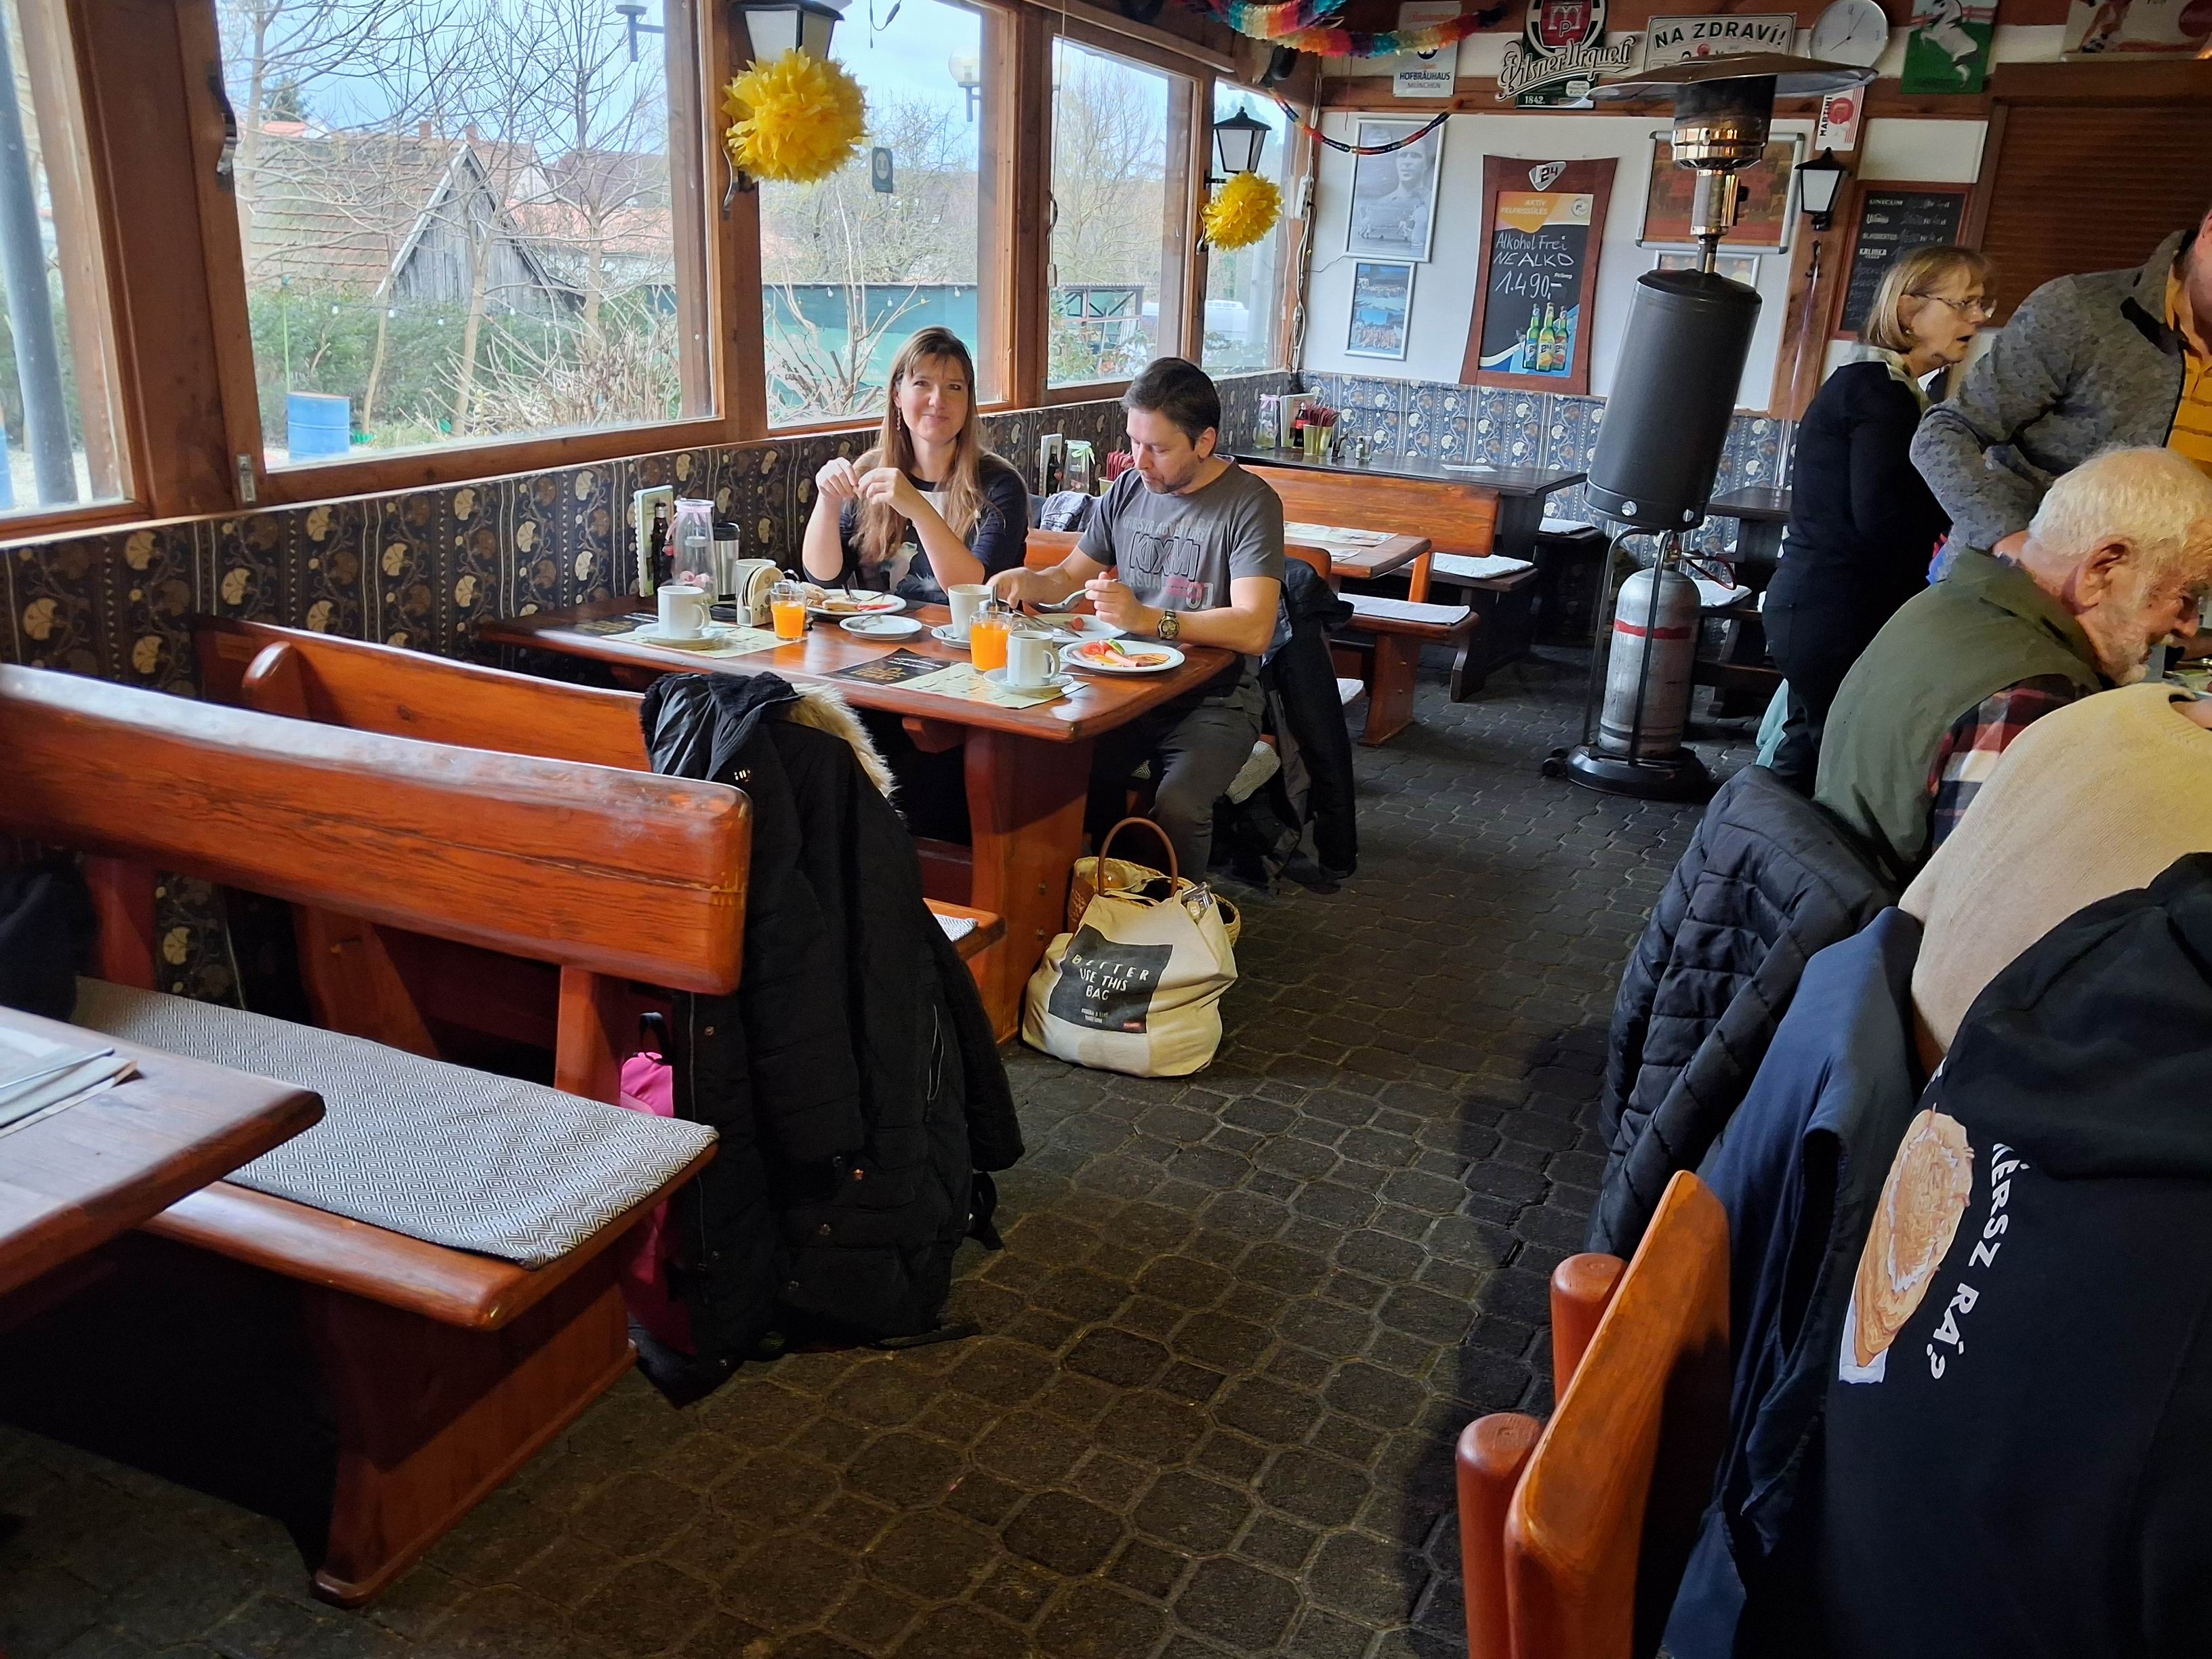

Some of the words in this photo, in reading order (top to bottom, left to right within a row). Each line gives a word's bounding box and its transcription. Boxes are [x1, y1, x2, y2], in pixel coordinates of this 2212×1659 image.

[1655, 28, 1684, 49] NA
[1693, 22, 1786, 46] ZDRAVÍ!
[1399, 71, 1450, 81] HOFBRÄUHAUS
[1498, 41, 1566, 92] Pilsner
[1566, 37, 1637, 81] Urquell
[1820, 97, 1833, 136] MARTINI
[1080, 968, 1097, 983] USE
[1101, 975, 1128, 991] THIS
[1086, 985, 1109, 1001] BAG
